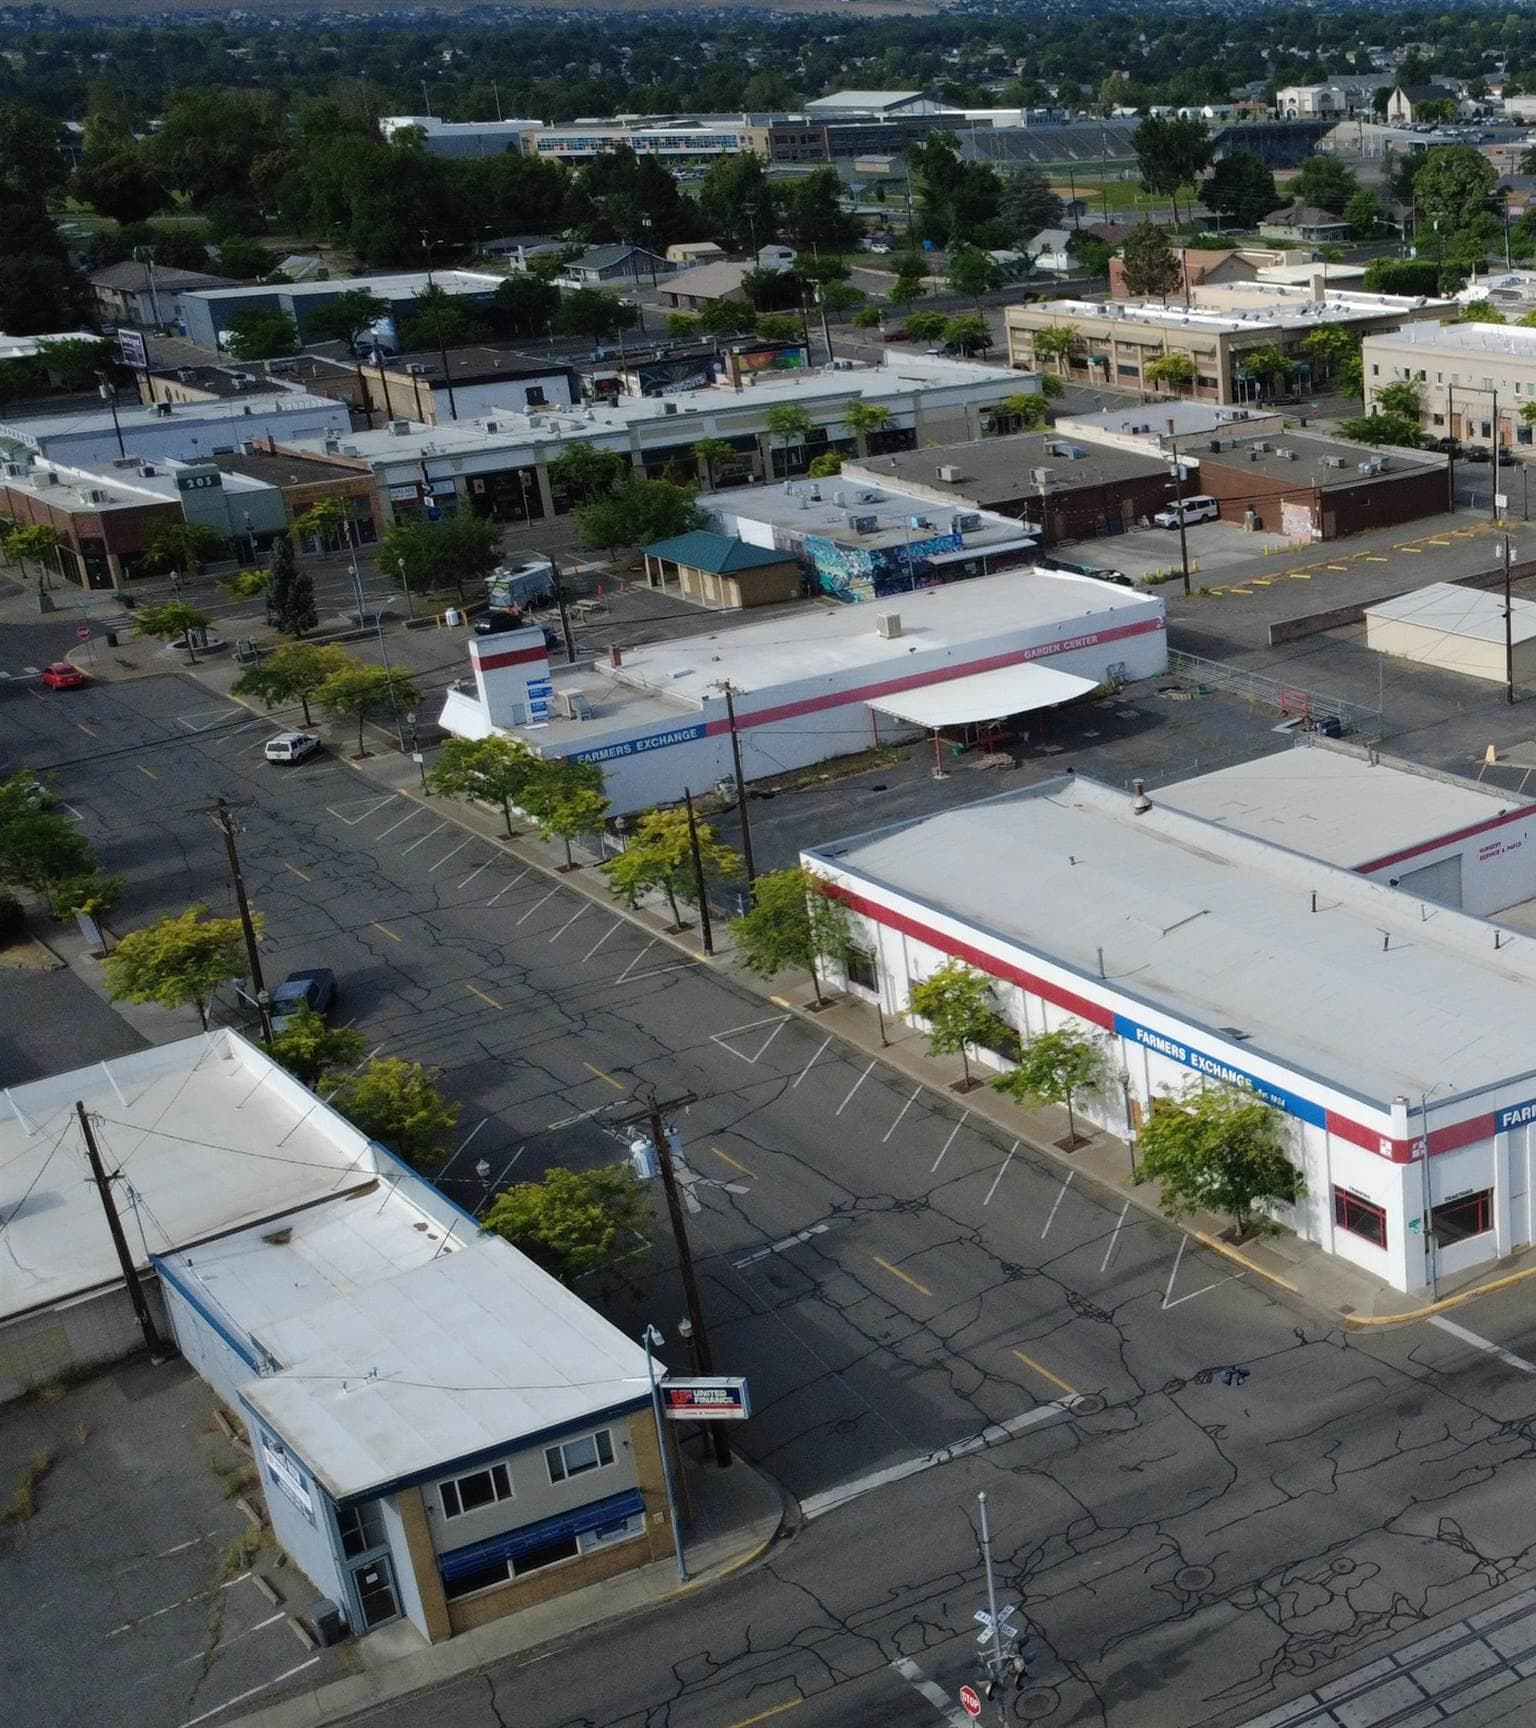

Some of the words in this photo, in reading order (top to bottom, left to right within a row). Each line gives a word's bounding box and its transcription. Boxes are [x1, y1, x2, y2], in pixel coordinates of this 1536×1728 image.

[1024, 644, 1061, 660] GARDEN
[1063, 635, 1098, 650] CENTER
[576, 744, 632, 765] FARMERS
[636, 728, 697, 751] EXCHANGE
[1136, 1028, 1187, 1061] FARMERS
[1190, 1052, 1253, 1092] EXCHANGE
[693, 1389, 727, 1397] UNITED
[694, 1396, 735, 1404] FINANCE
[960, 1690, 979, 1709] STOP
